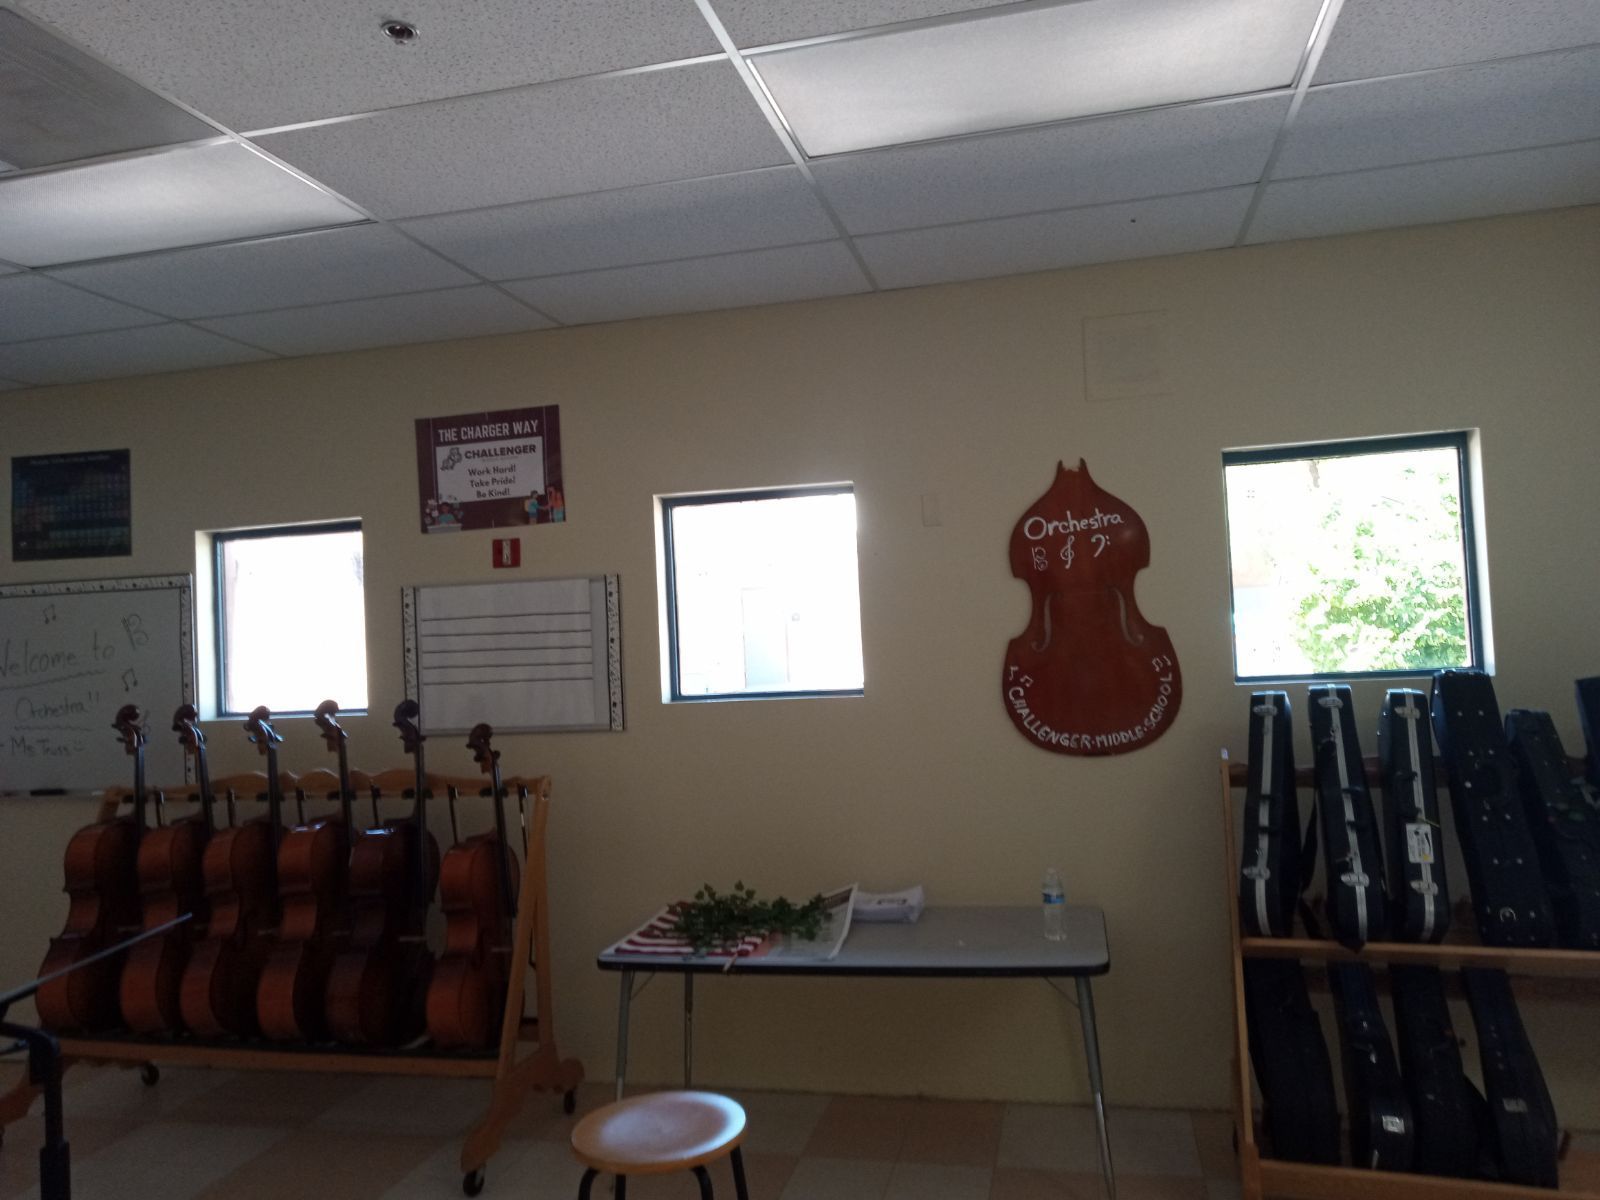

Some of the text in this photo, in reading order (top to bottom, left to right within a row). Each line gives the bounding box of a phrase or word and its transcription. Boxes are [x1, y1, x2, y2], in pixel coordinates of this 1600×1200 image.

[438, 420, 539, 442] THE CHARGER WAY
[464, 444, 537, 459] CHALLENGER
[468, 464, 516, 477] Work Hard!
[470, 476, 516, 488] Take Pride!
[476, 488, 510, 499] Be Kind!
[1024, 507, 1125, 540] Orchestra
[92, 629, 116, 661] to
[1008, 672, 1173, 749] CHALLENGER MIDDLE SCHOOL
